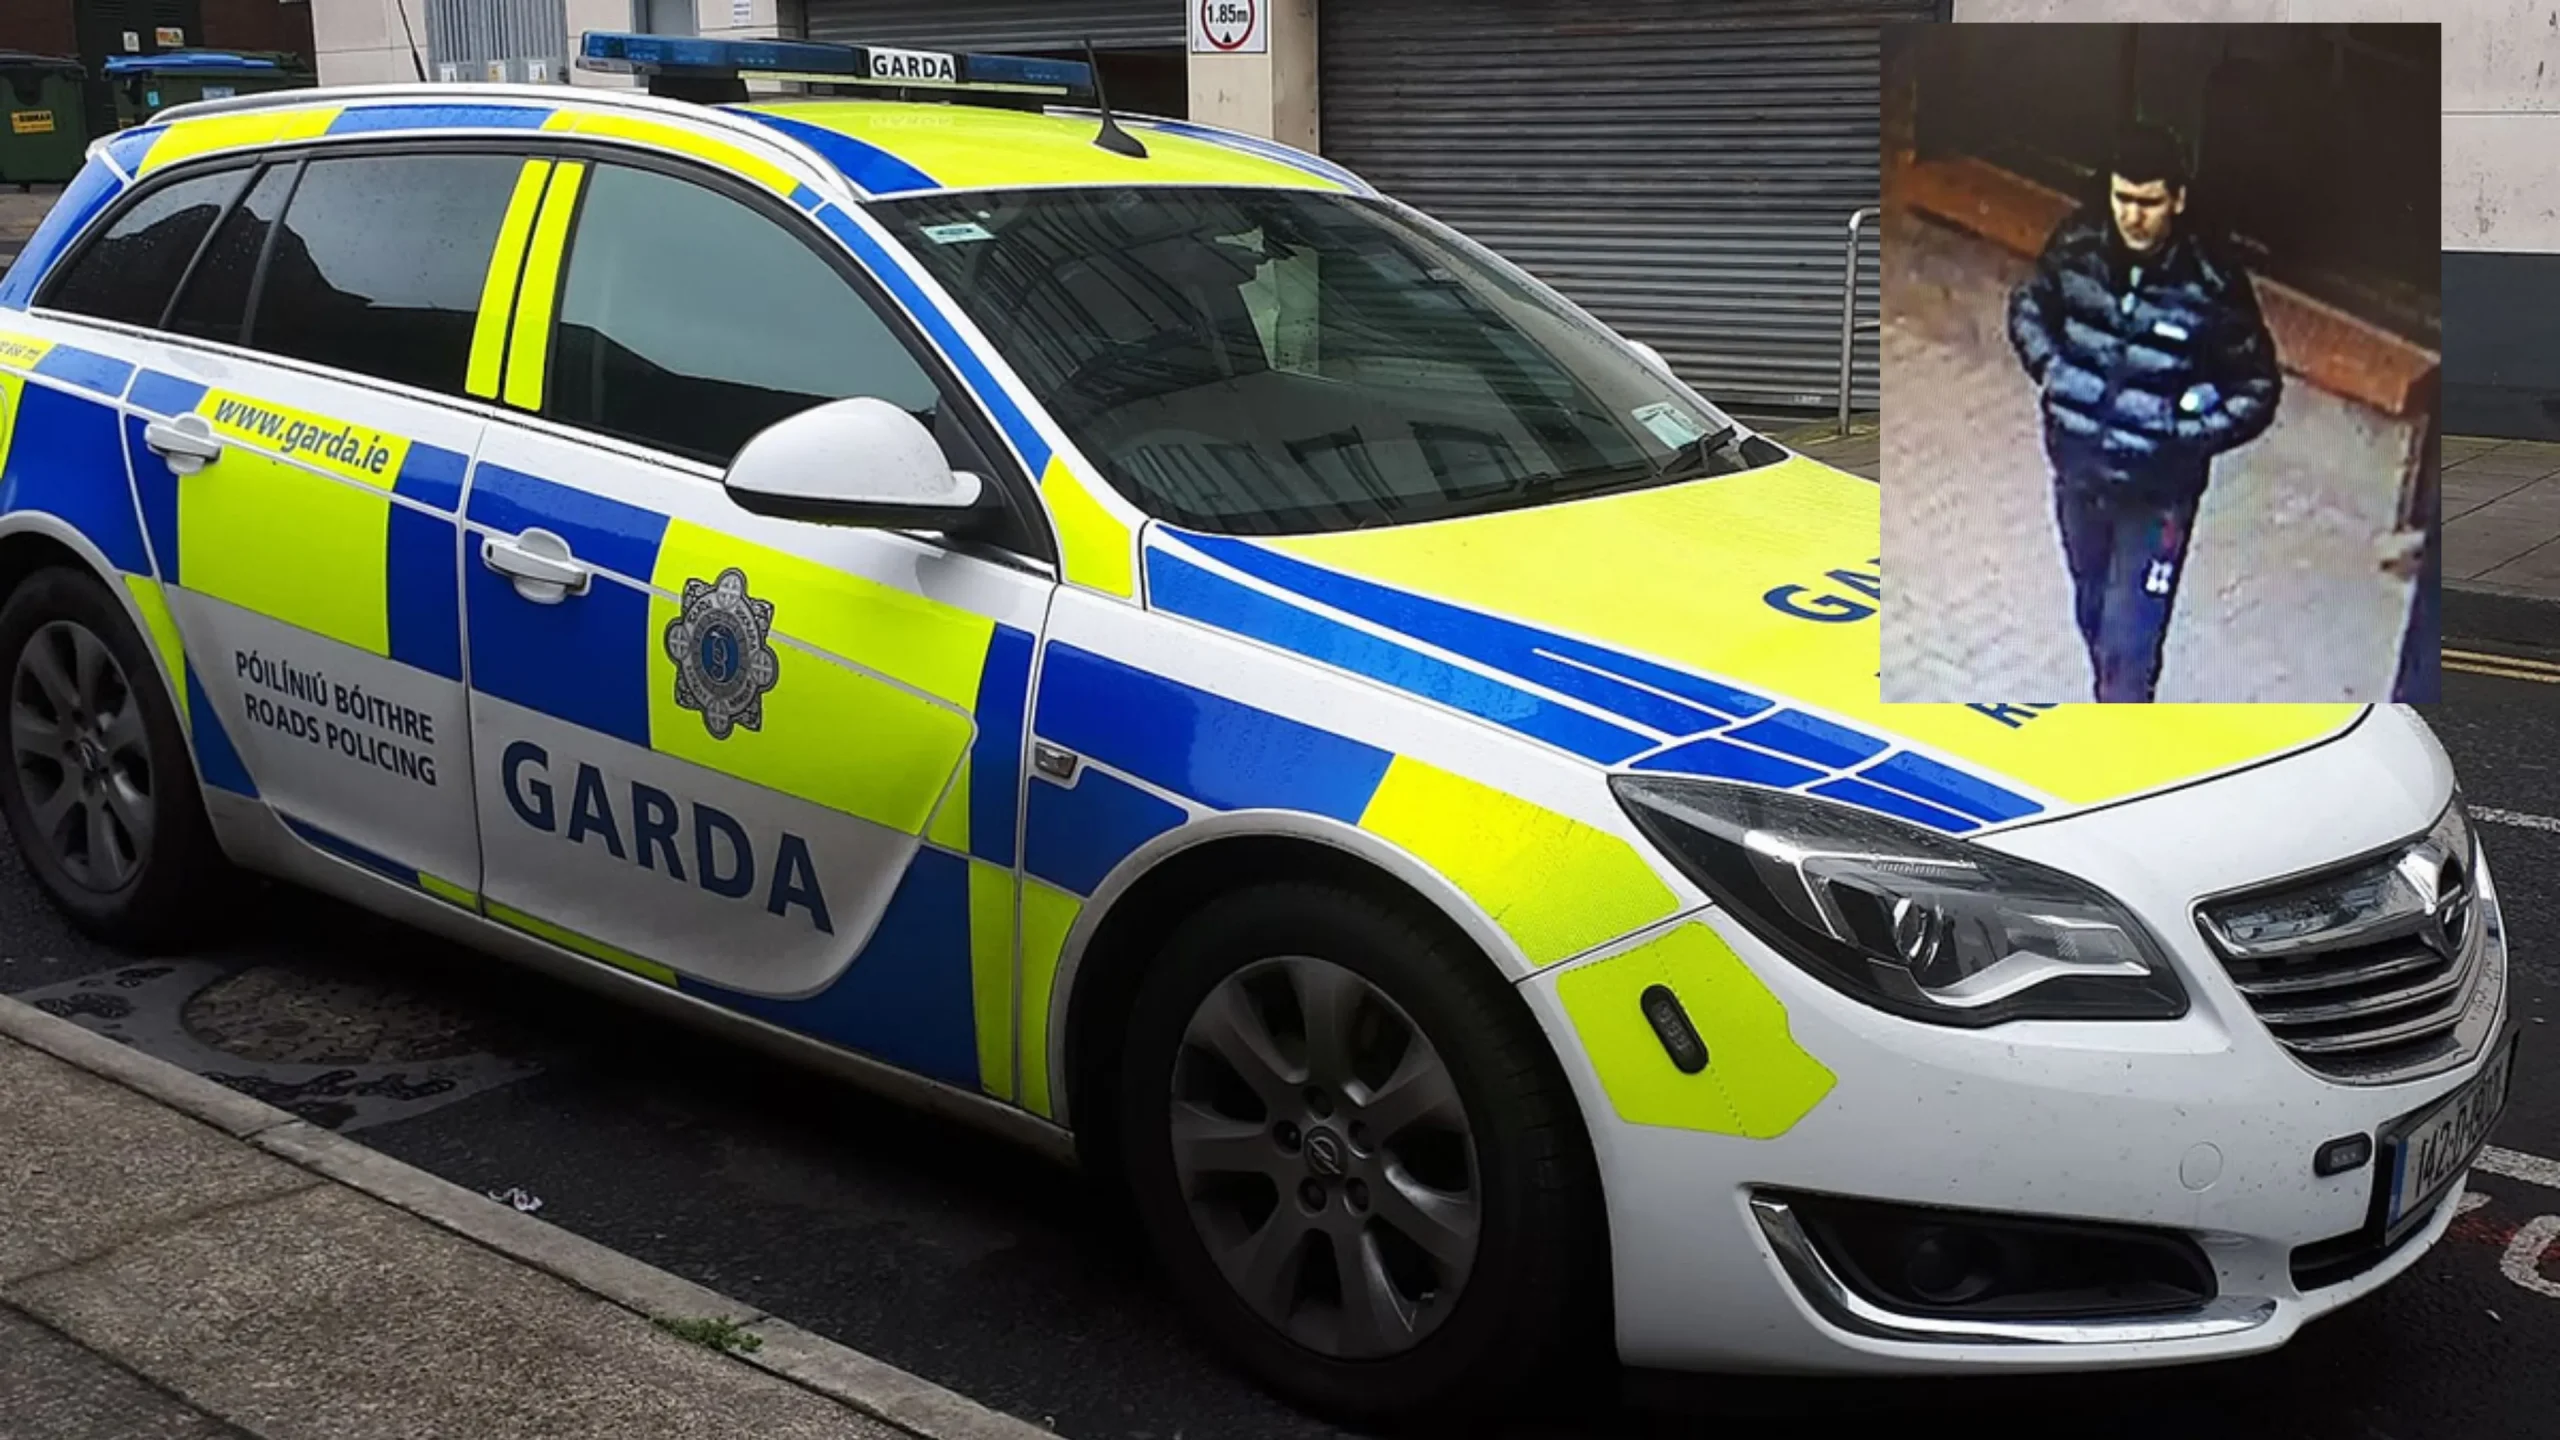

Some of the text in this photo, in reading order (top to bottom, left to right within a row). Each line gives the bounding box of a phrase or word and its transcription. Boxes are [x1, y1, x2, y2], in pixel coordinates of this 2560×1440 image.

[1207, 3, 1249, 24] 1.85m
[872, 54, 953, 79] GARDA
[214, 398, 389, 475] www.garda.ie
[235, 650, 434, 745] PÓILÍNIÚ BÓITHRE
[245, 692, 436, 787] ROADS POLICING
[502, 739, 835, 937] GARDA
